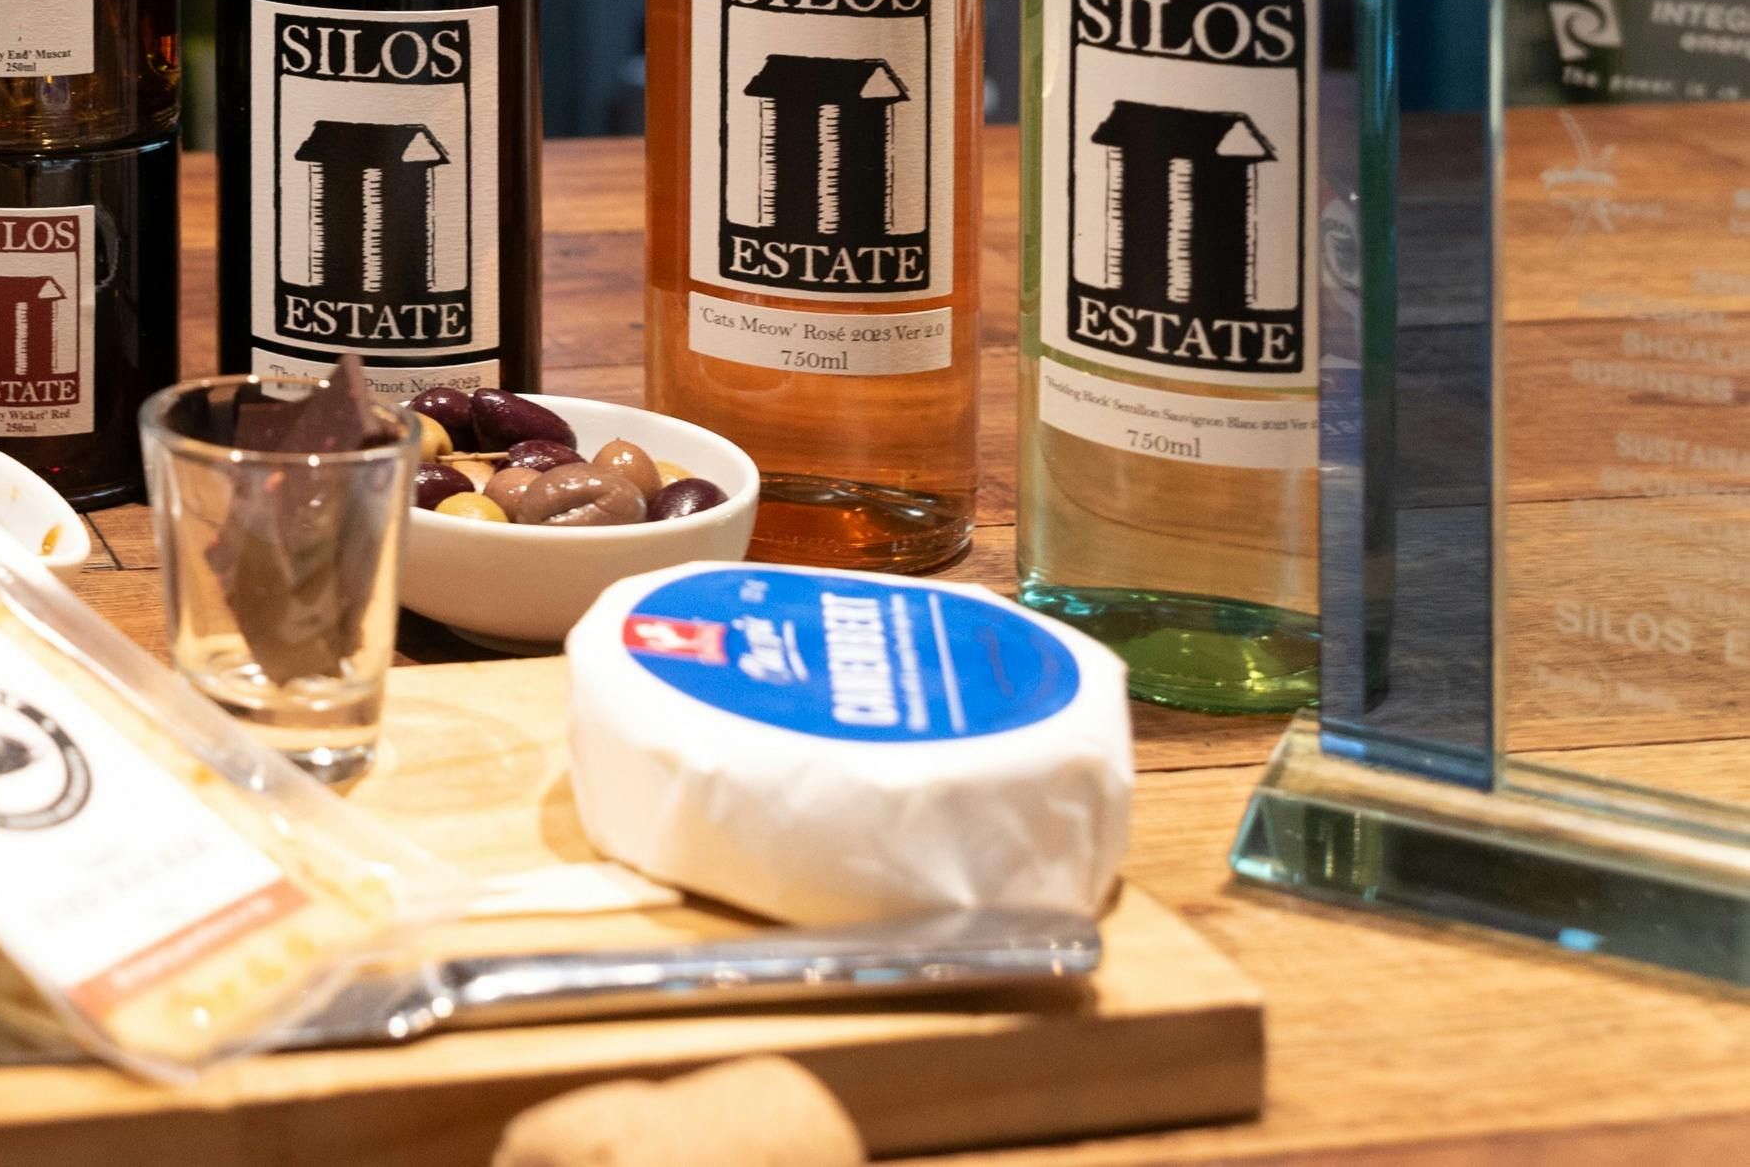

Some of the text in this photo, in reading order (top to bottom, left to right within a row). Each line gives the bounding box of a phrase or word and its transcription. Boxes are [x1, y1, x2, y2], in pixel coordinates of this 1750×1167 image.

[35, 49, 72, 59] Muscat
[281, 23, 463, 81] SILOS
[5, 62, 37, 72] 250ml
[728, 236, 925, 285] ESTATE
[283, 294, 467, 340] ESTATE
[699, 305, 736, 328] 'Cats
[740, 315, 797, 337] Meow'
[803, 324, 847, 342] Rosé
[850, 328, 891, 342] 2023
[895, 325, 921, 340] Ver
[1076, 294, 1296, 366] ESTATE
[780, 349, 849, 370] 750ml
[364, 378, 405, 393] Pinot
[51, 408, 71, 419] Red
[1227, 416, 1260, 429] Blanc
[5, 422, 37, 432] 250ml
[1124, 429, 1203, 458] 750ml
[1554, 599, 1692, 655] SILOS
